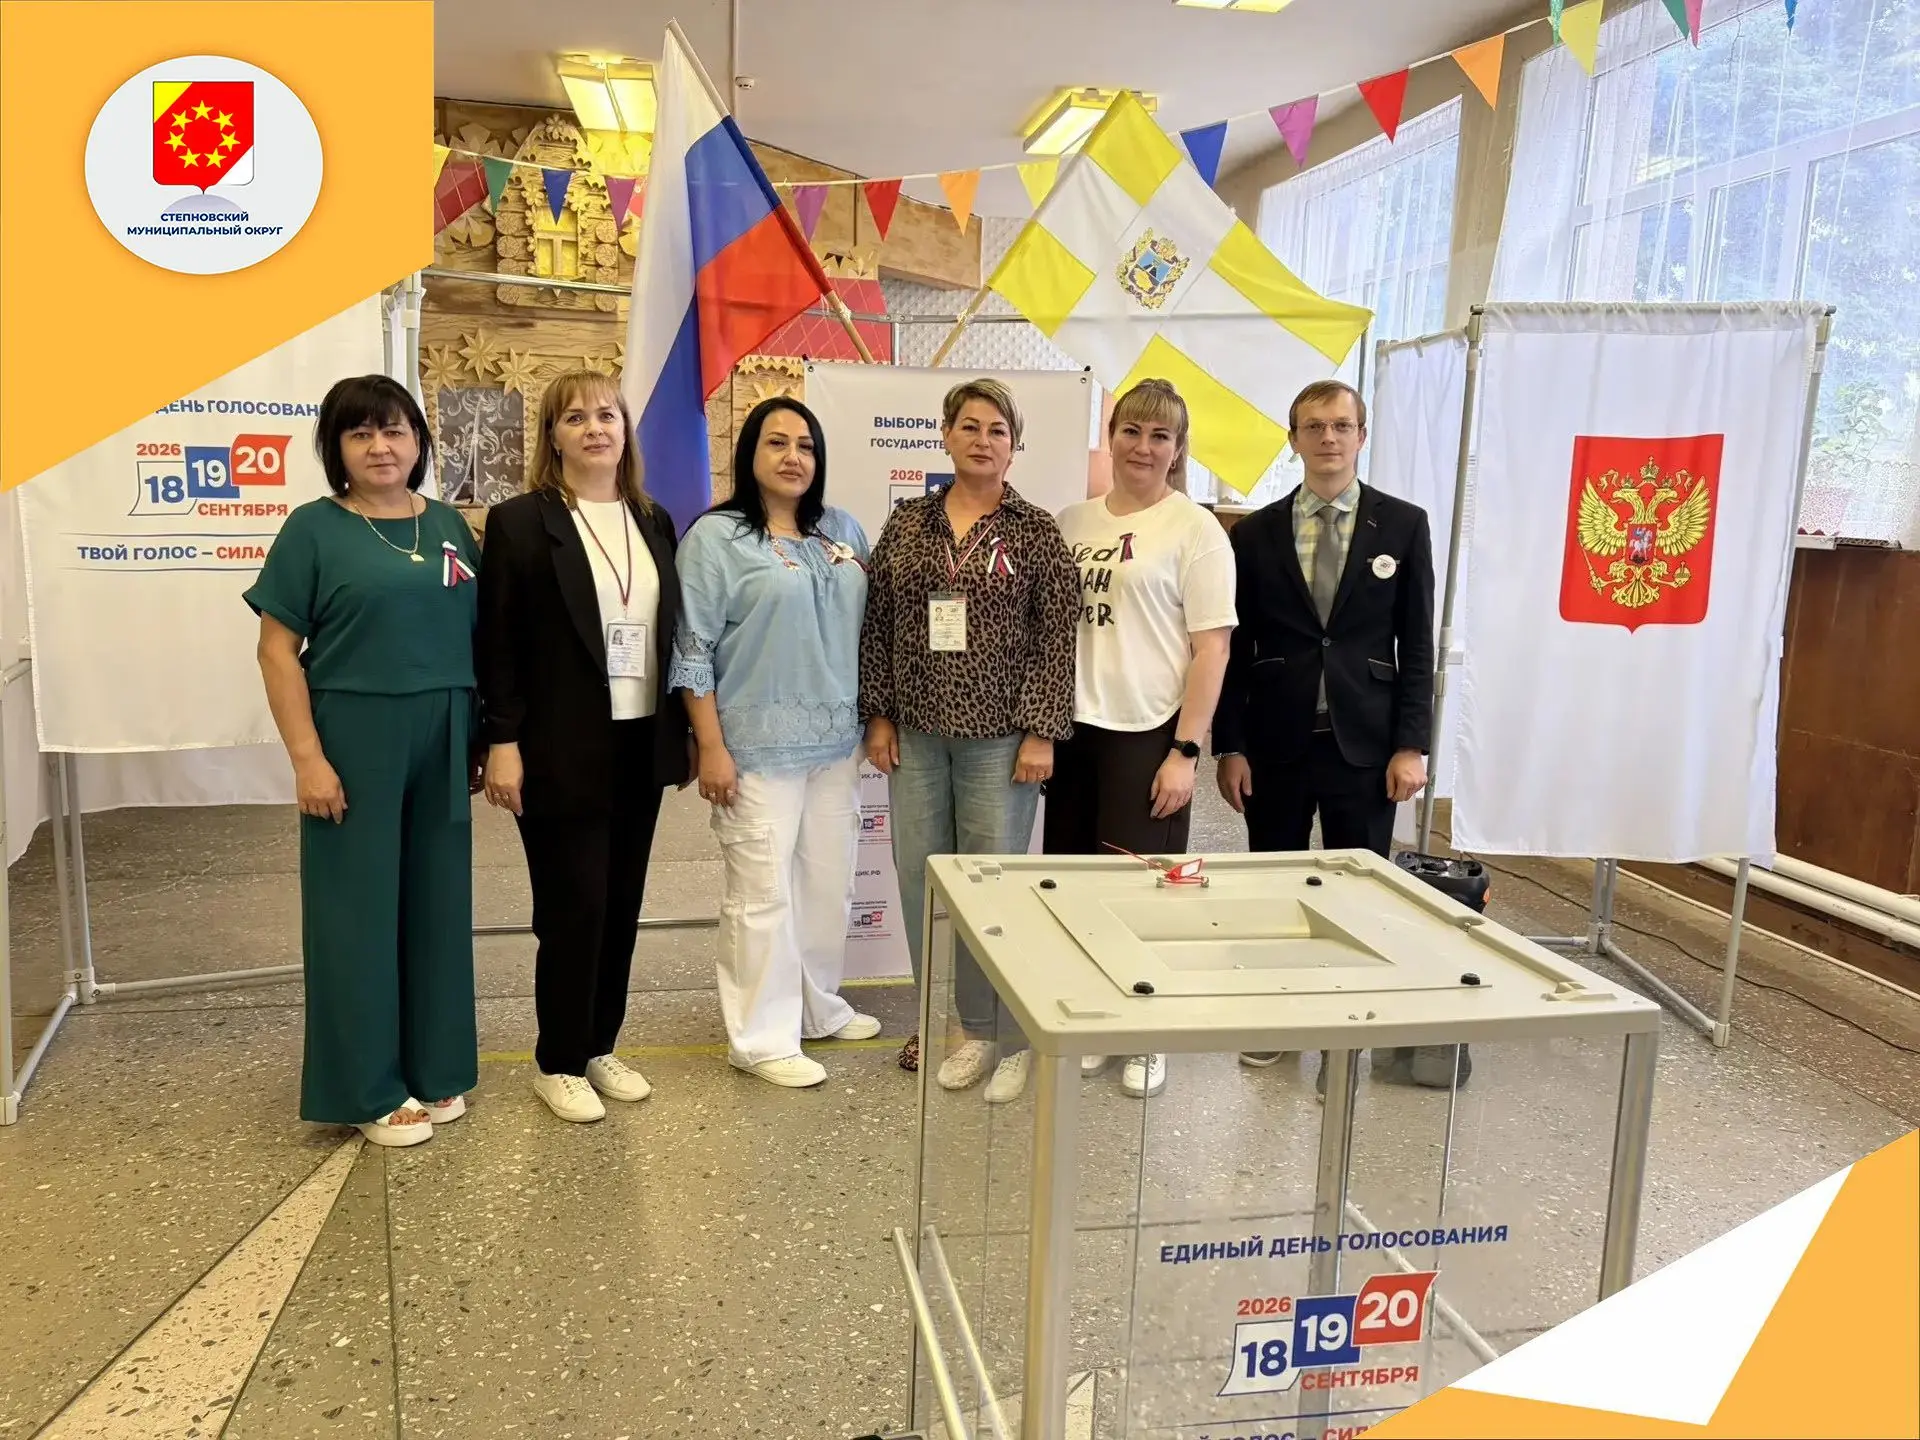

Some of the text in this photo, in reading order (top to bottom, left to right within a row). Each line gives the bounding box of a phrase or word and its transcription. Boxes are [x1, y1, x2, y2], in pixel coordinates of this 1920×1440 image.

[207, 400, 319, 417] ГОЛОСОВАН
[874, 416, 937, 430] ВЫБОРЫ
[136, 443, 181, 457] 2026
[144, 446, 281, 504] 18 19 20
[890, 469, 923, 481] 2026
[198, 503, 288, 517] СЕНТЯБРЯ
[78, 544, 128, 561] ТВОЙ
[134, 546, 198, 560] ГОЛОС
[216, 546, 265, 560] СИЛА
[1160, 1225, 1508, 1264] ЕДИНЫЙ ДЕНЬ ГОЛОСОВАНИЯ
[1237, 1297, 1292, 1317] 2026
[1241, 1289, 1419, 1379] 18 19 20
[1301, 1366, 1419, 1391] СЕНТЯБРЯ
